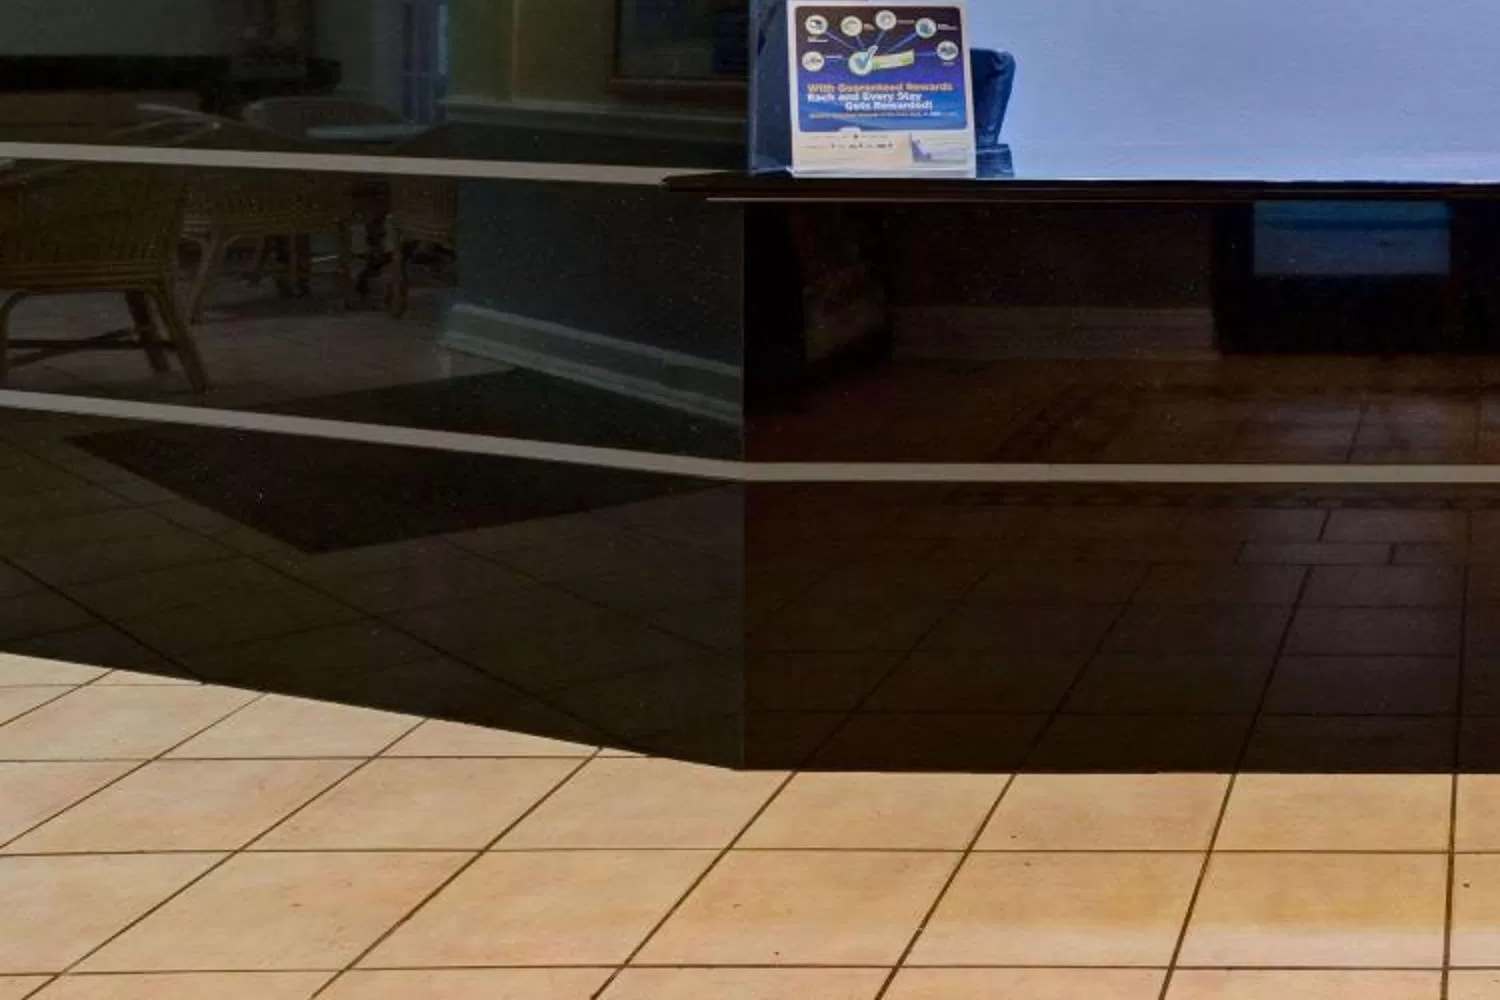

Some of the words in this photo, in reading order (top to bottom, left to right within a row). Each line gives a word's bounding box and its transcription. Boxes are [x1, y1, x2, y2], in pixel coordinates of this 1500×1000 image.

[905, 81, 953, 92] Rewards
[862, 91, 894, 102] Every
[896, 91, 923, 101] Stay
